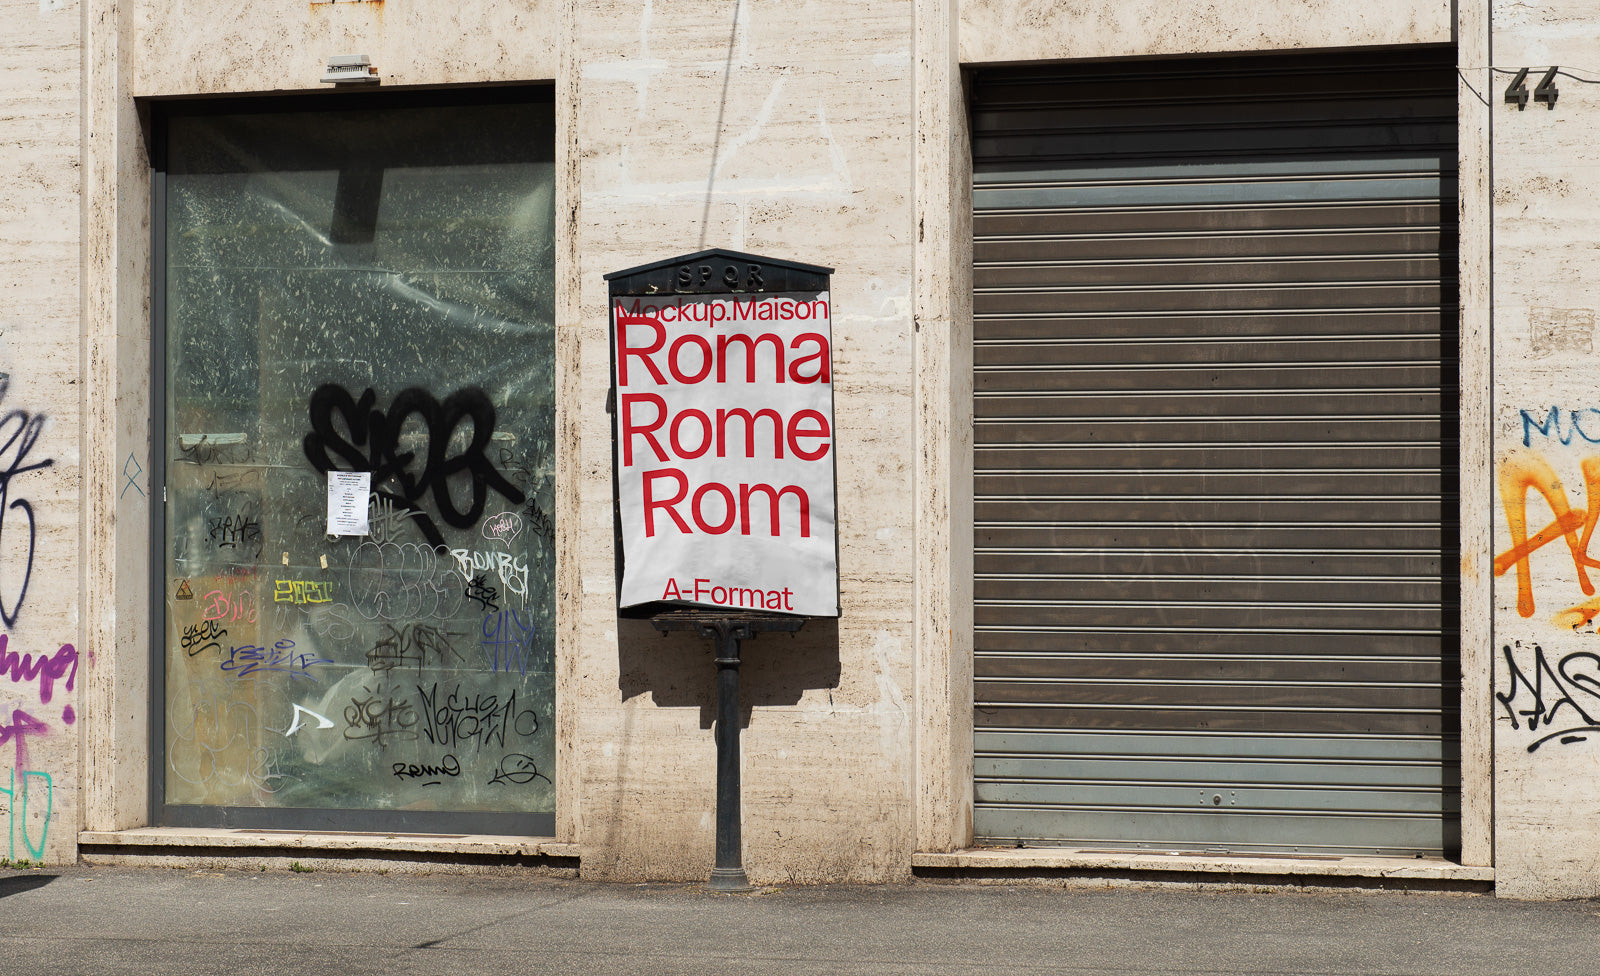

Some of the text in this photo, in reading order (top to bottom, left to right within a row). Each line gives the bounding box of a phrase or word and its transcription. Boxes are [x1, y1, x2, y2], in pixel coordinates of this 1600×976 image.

[1504, 66, 1558, 111] 44
[679, 264, 764, 288] SPQR
[616, 295, 828, 328] Mockup.Maison
[617, 317, 830, 386] Roma
[621, 393, 830, 467] Rome
[642, 468, 811, 538] Rom
[662, 578, 794, 611] A-Format
